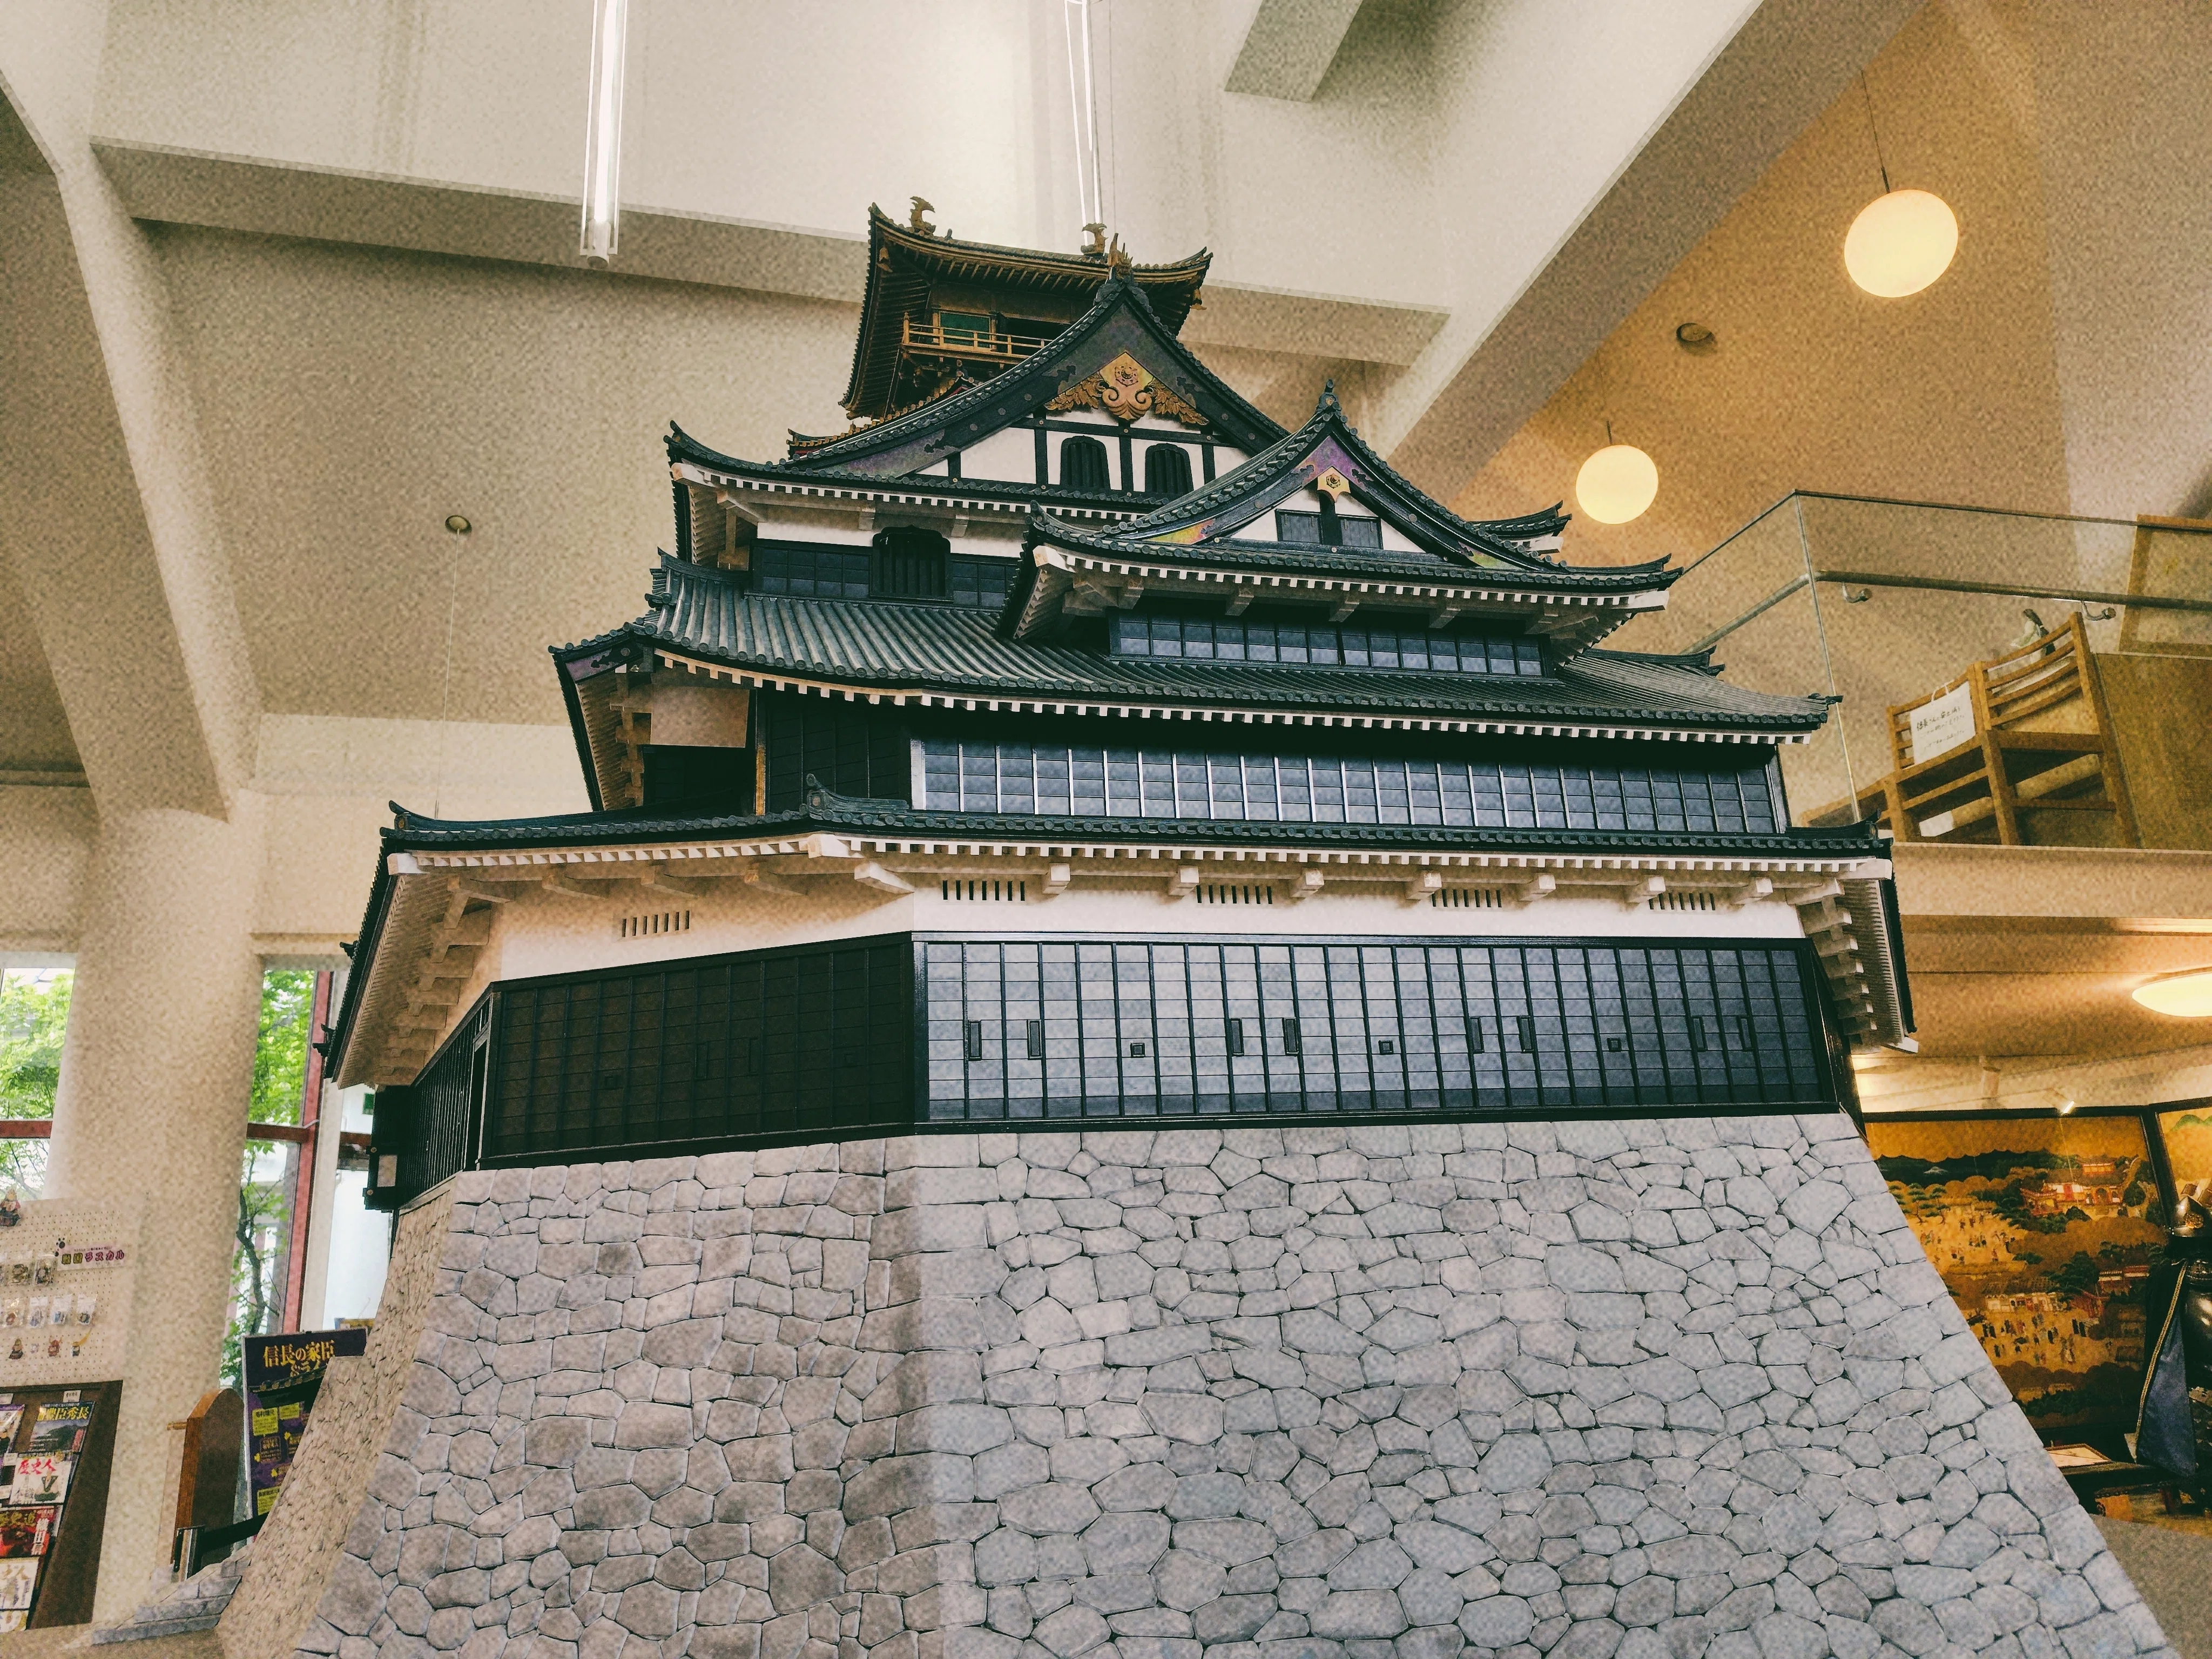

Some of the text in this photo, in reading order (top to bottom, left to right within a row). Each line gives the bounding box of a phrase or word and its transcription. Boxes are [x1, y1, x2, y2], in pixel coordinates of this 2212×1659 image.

[264, 1340, 334, 1367] 信長の家臣
[17, 1458, 56, 1475] 歴史人
